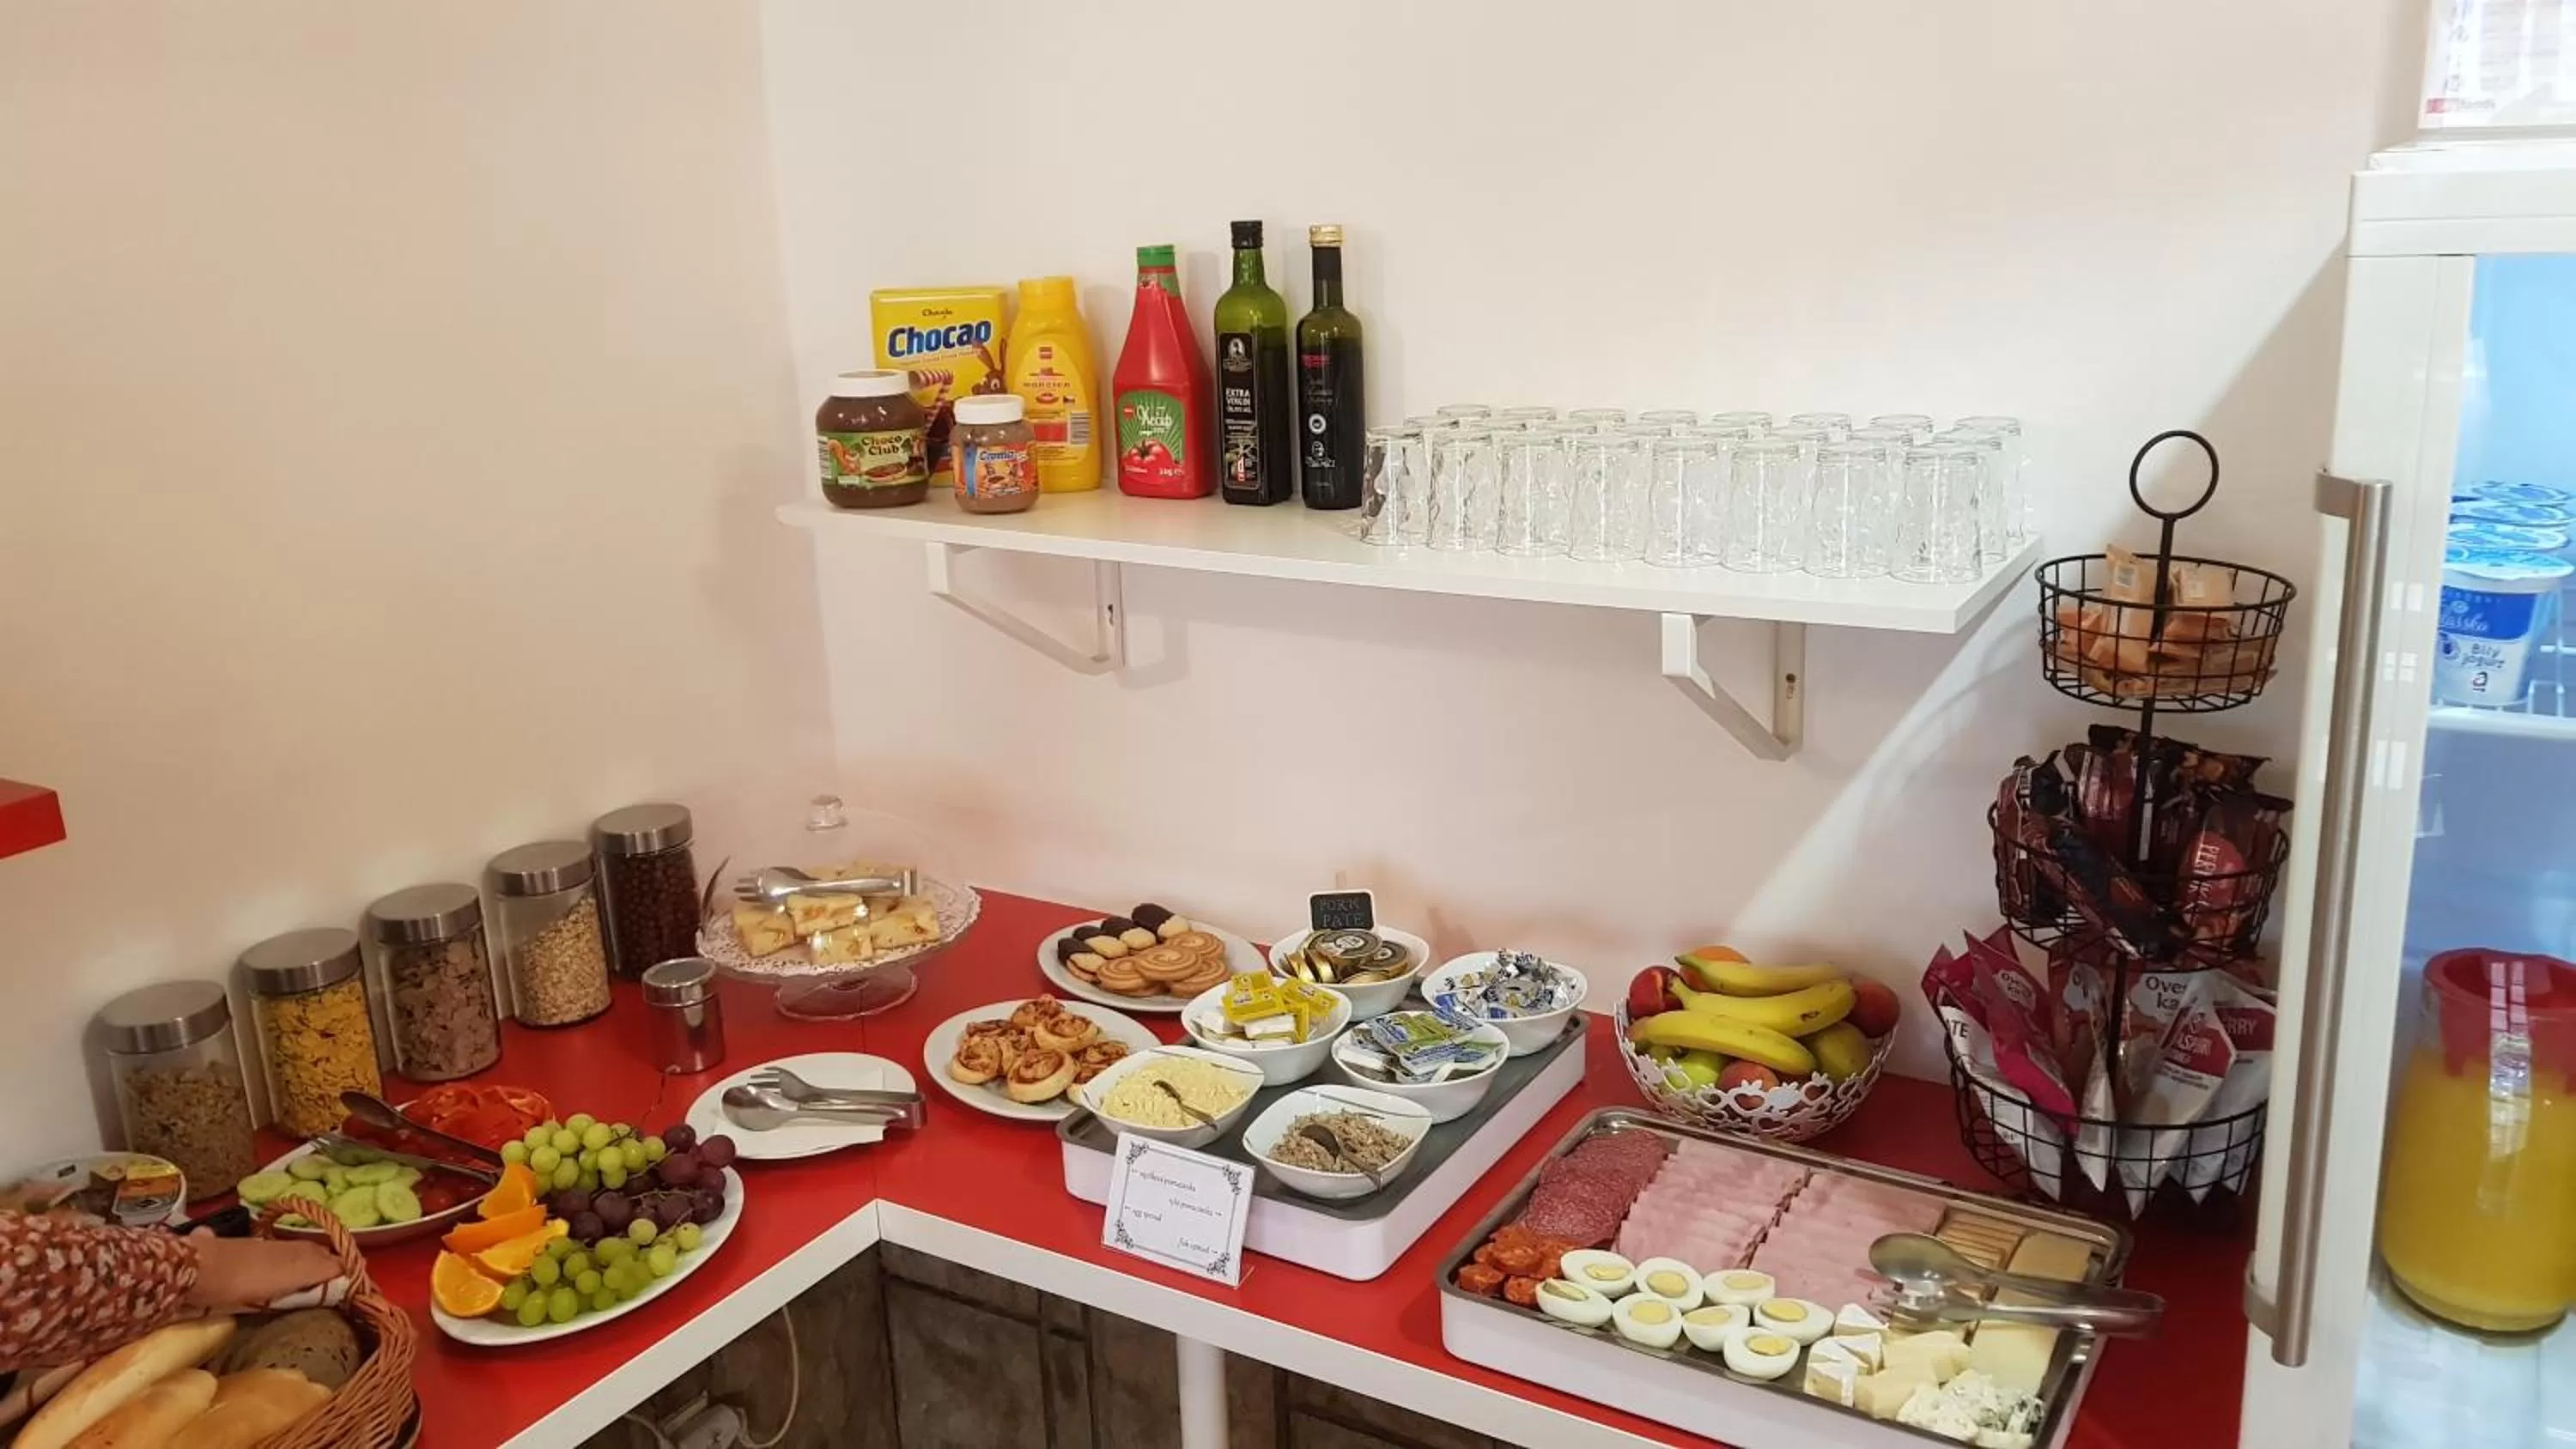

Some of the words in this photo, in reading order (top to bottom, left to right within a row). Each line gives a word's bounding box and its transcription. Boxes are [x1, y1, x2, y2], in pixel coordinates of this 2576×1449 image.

[888, 320, 992, 358] Chocao
[861, 435, 902, 446] Choco
[869, 444, 900, 455] Club
[1319, 899, 1361, 911] PORK
